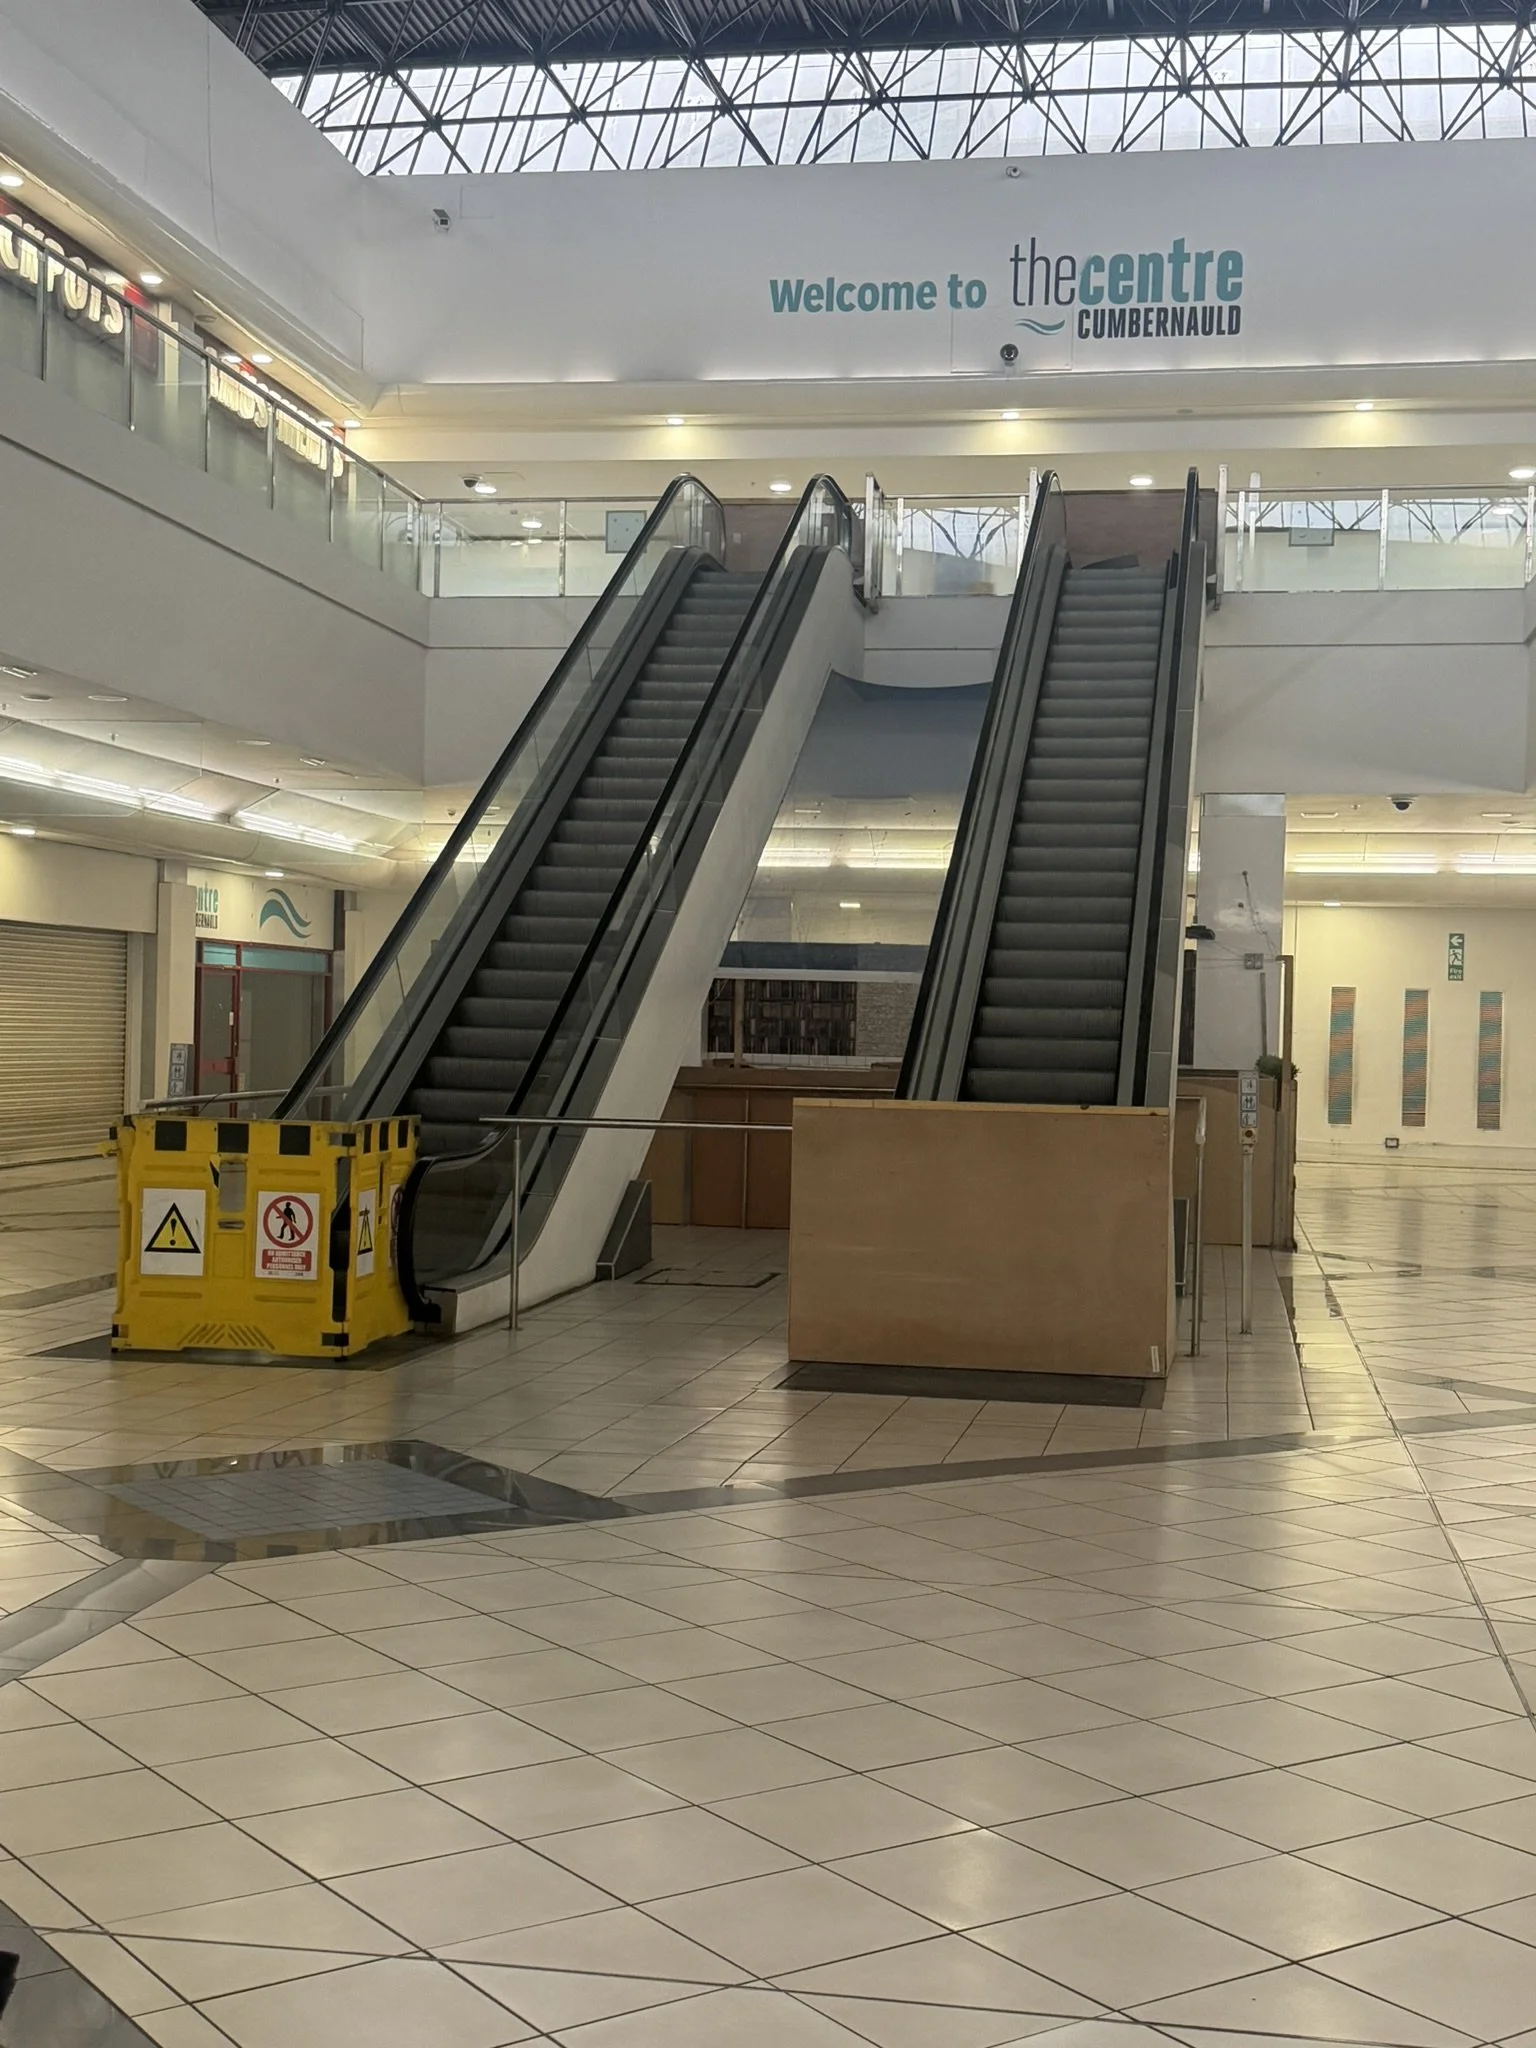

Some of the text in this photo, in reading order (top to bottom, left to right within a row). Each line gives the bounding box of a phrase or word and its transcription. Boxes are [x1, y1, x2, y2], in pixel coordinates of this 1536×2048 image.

[769, 277, 938, 313] Welcome
[947, 273, 987, 309] to
[1077, 304, 1242, 340] CUMBERNAULD
